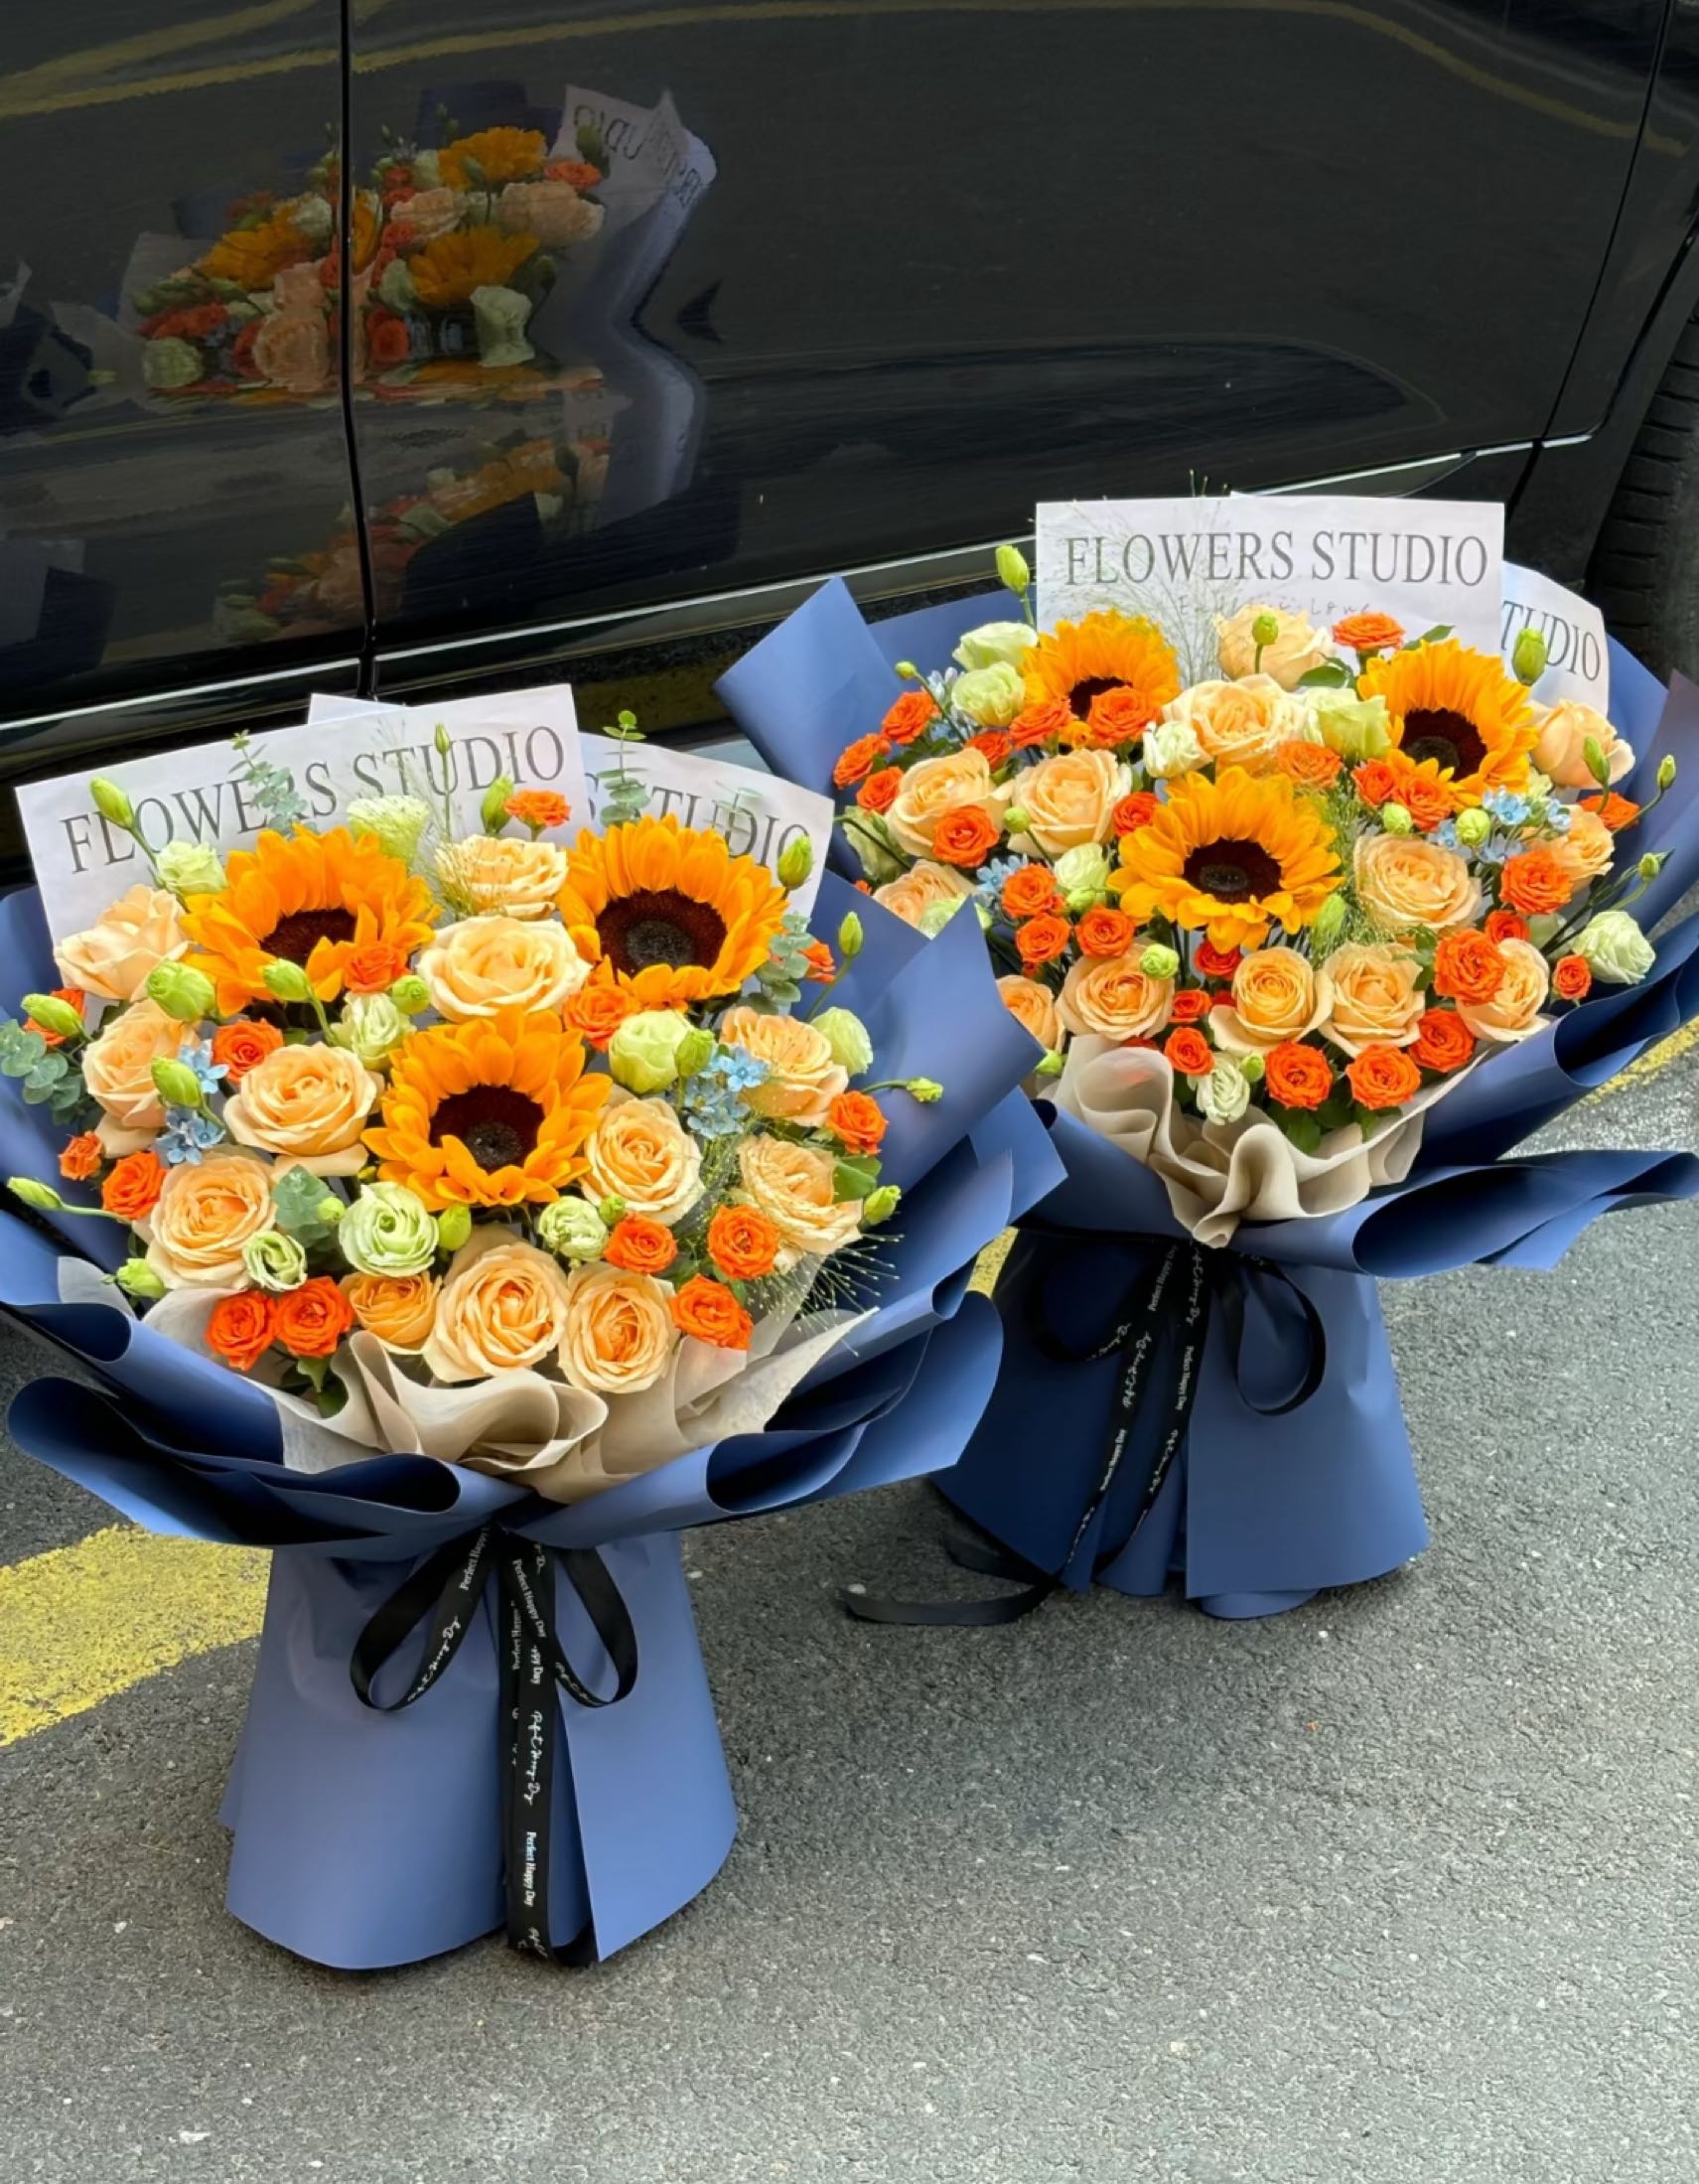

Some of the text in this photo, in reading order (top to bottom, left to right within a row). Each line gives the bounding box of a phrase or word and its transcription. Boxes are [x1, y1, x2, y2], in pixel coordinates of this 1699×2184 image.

[1063, 530, 1488, 587] FLOWERS STUDIO
[353, 725, 565, 796] STUDIO
[522, 1862, 537, 1890] Happy
